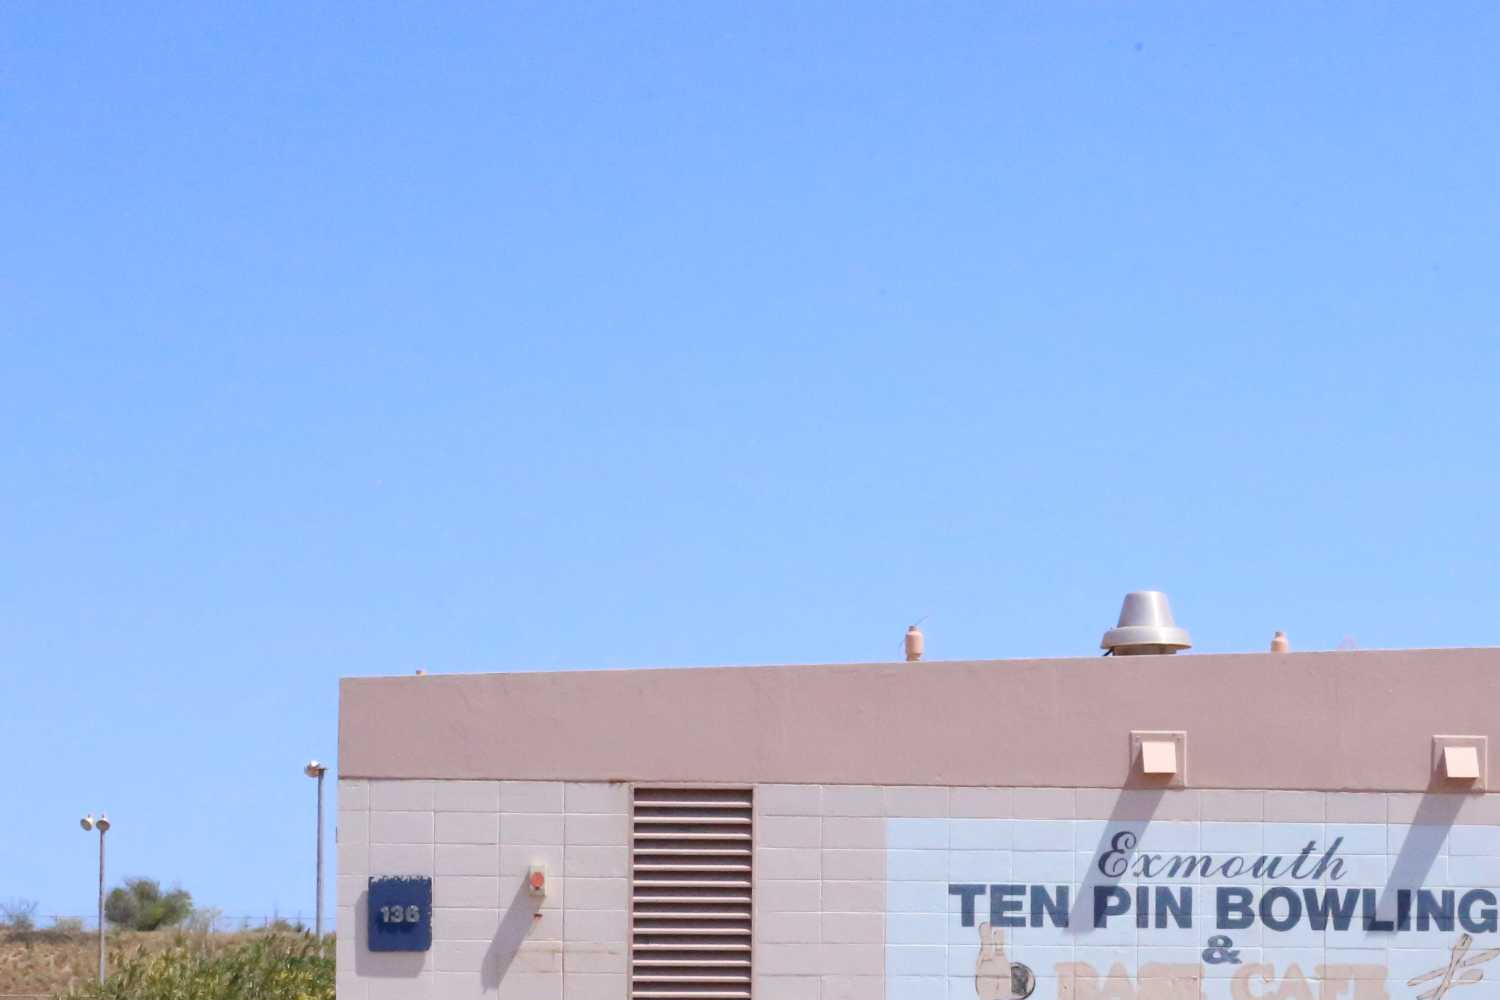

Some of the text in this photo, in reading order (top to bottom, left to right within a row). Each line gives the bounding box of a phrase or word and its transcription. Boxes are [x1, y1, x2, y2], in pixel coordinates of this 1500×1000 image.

[1097, 830, 1347, 880] Exmouth
[381, 904, 420, 923] 136
[948, 884, 1498, 934] TEN PIN BOWLING
[1202, 934, 1242, 965] &
